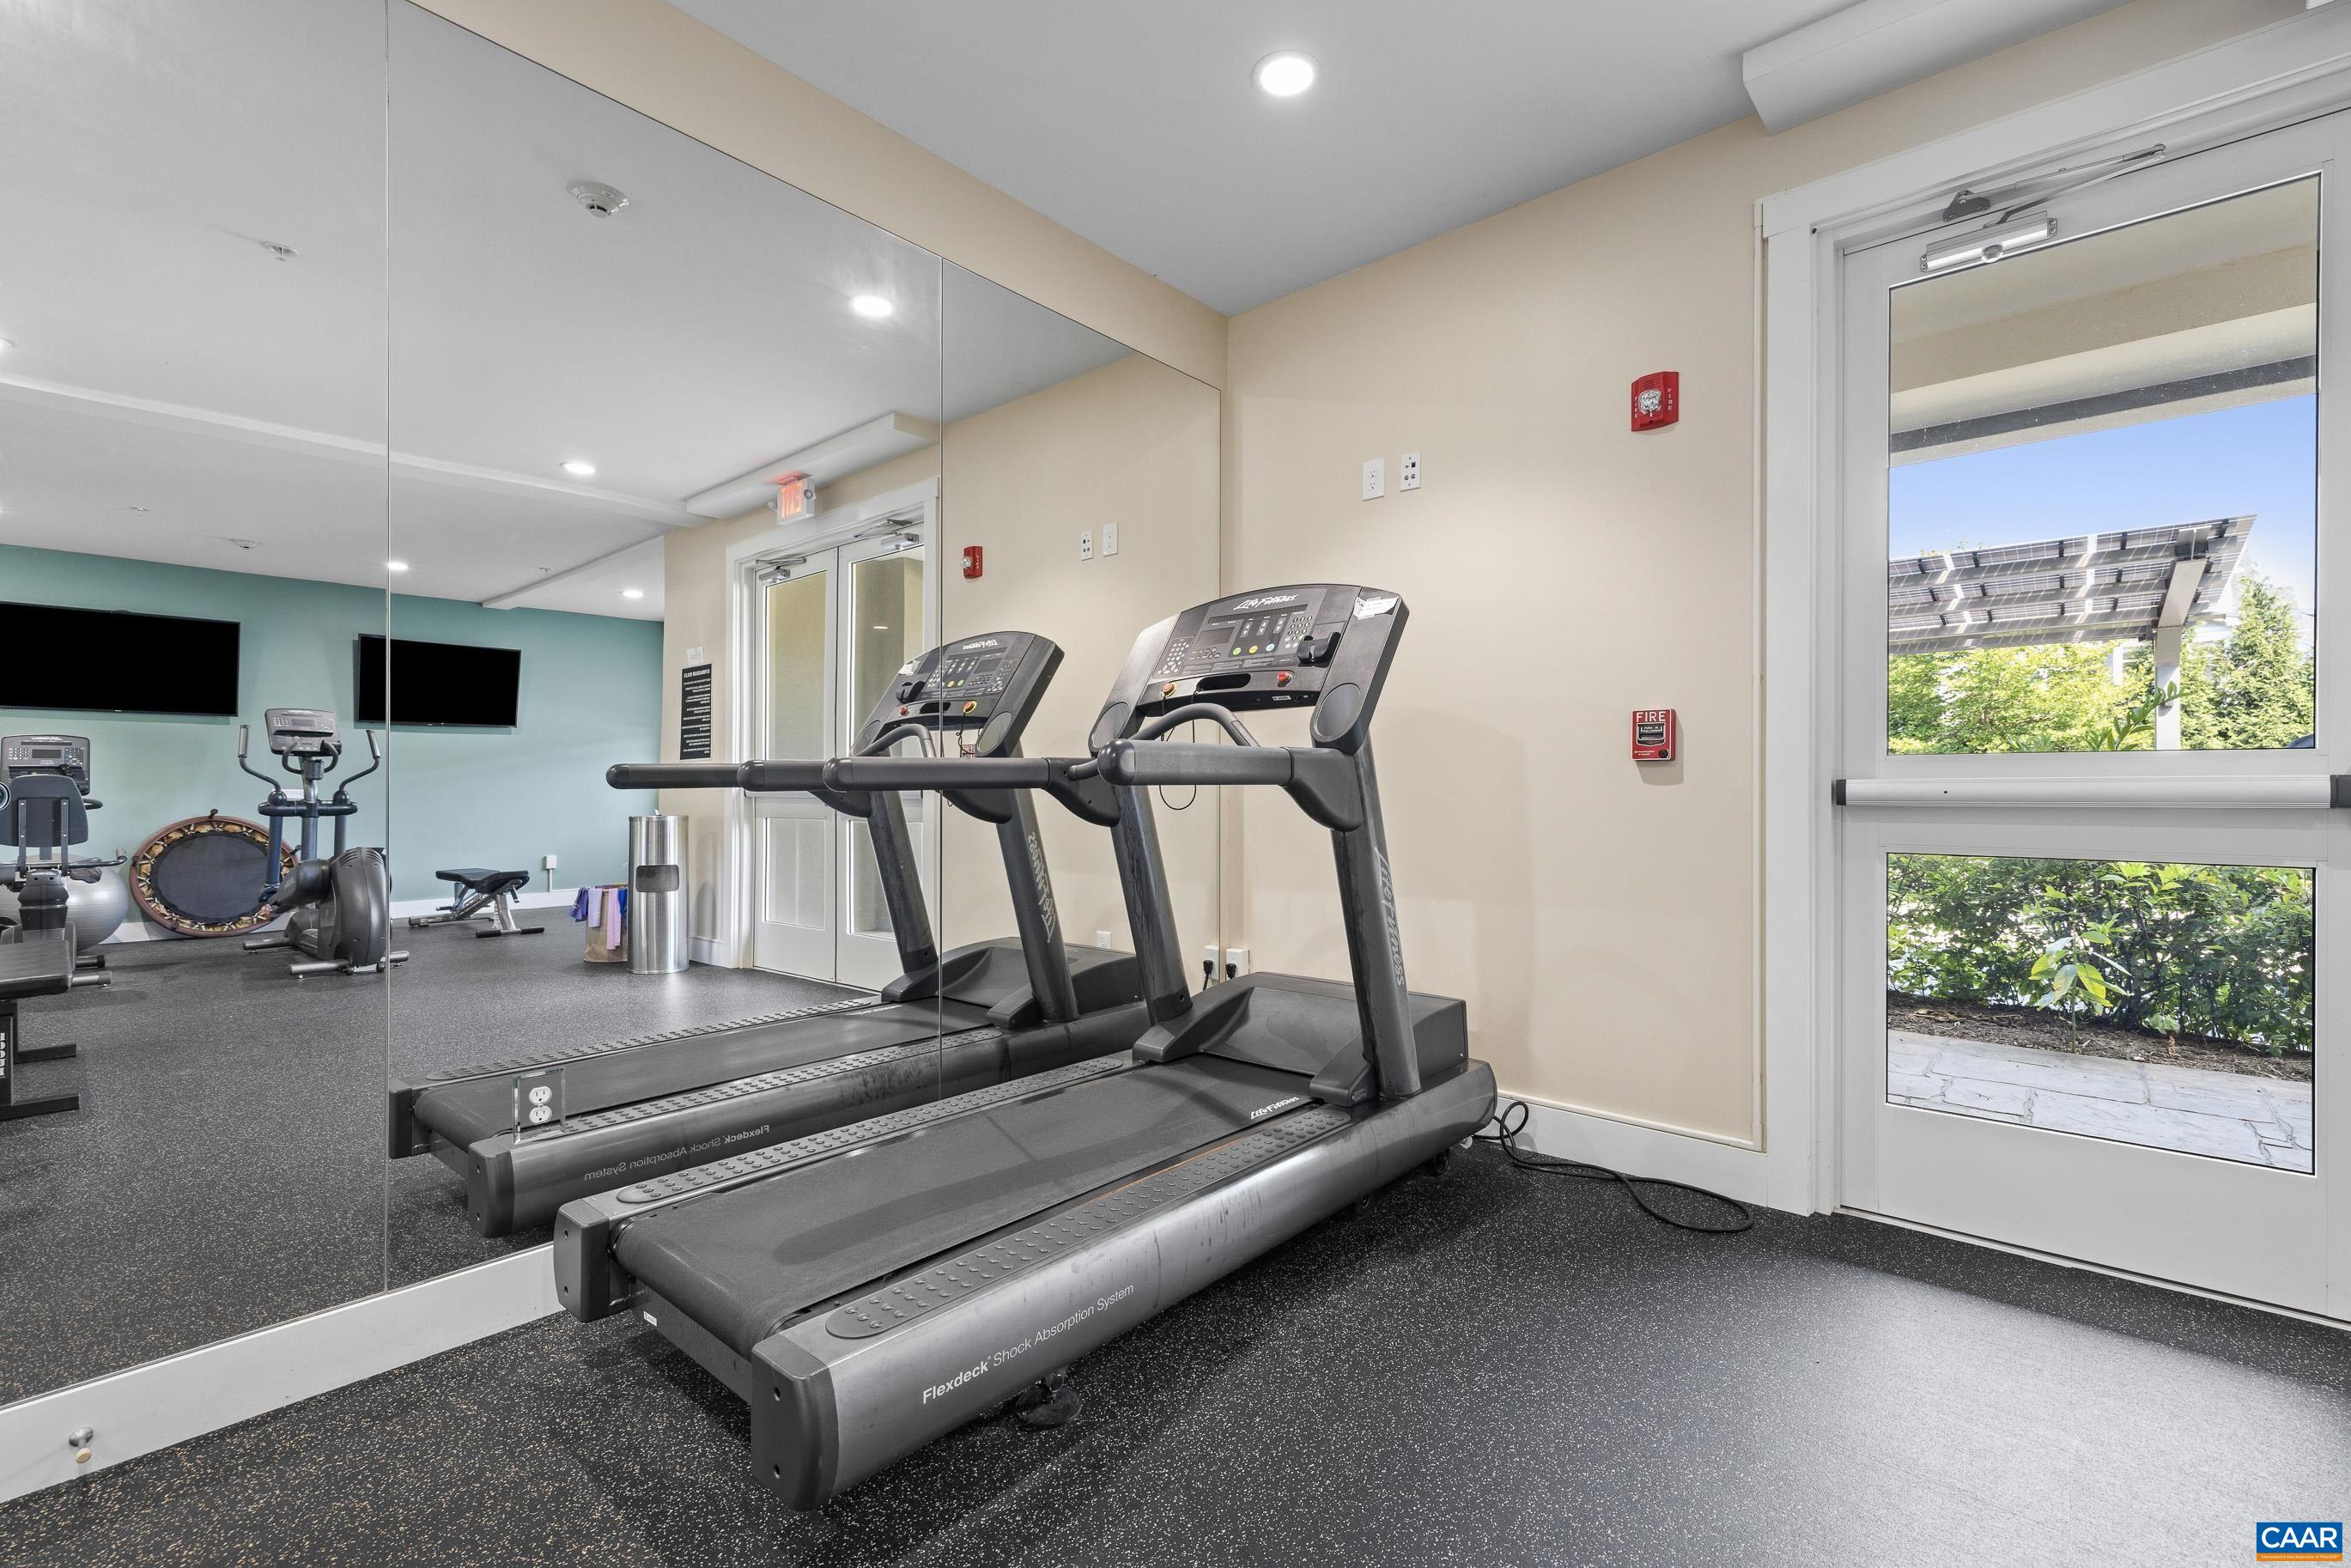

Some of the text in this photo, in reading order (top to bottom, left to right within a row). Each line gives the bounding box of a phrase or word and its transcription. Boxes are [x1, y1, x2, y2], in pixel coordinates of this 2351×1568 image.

[1636, 711, 1667, 723] FIRE
[993, 1338, 1032, 1367] Shock
[1035, 1305, 1095, 1345] Absorption
[1097, 1284, 1134, 1312] System
